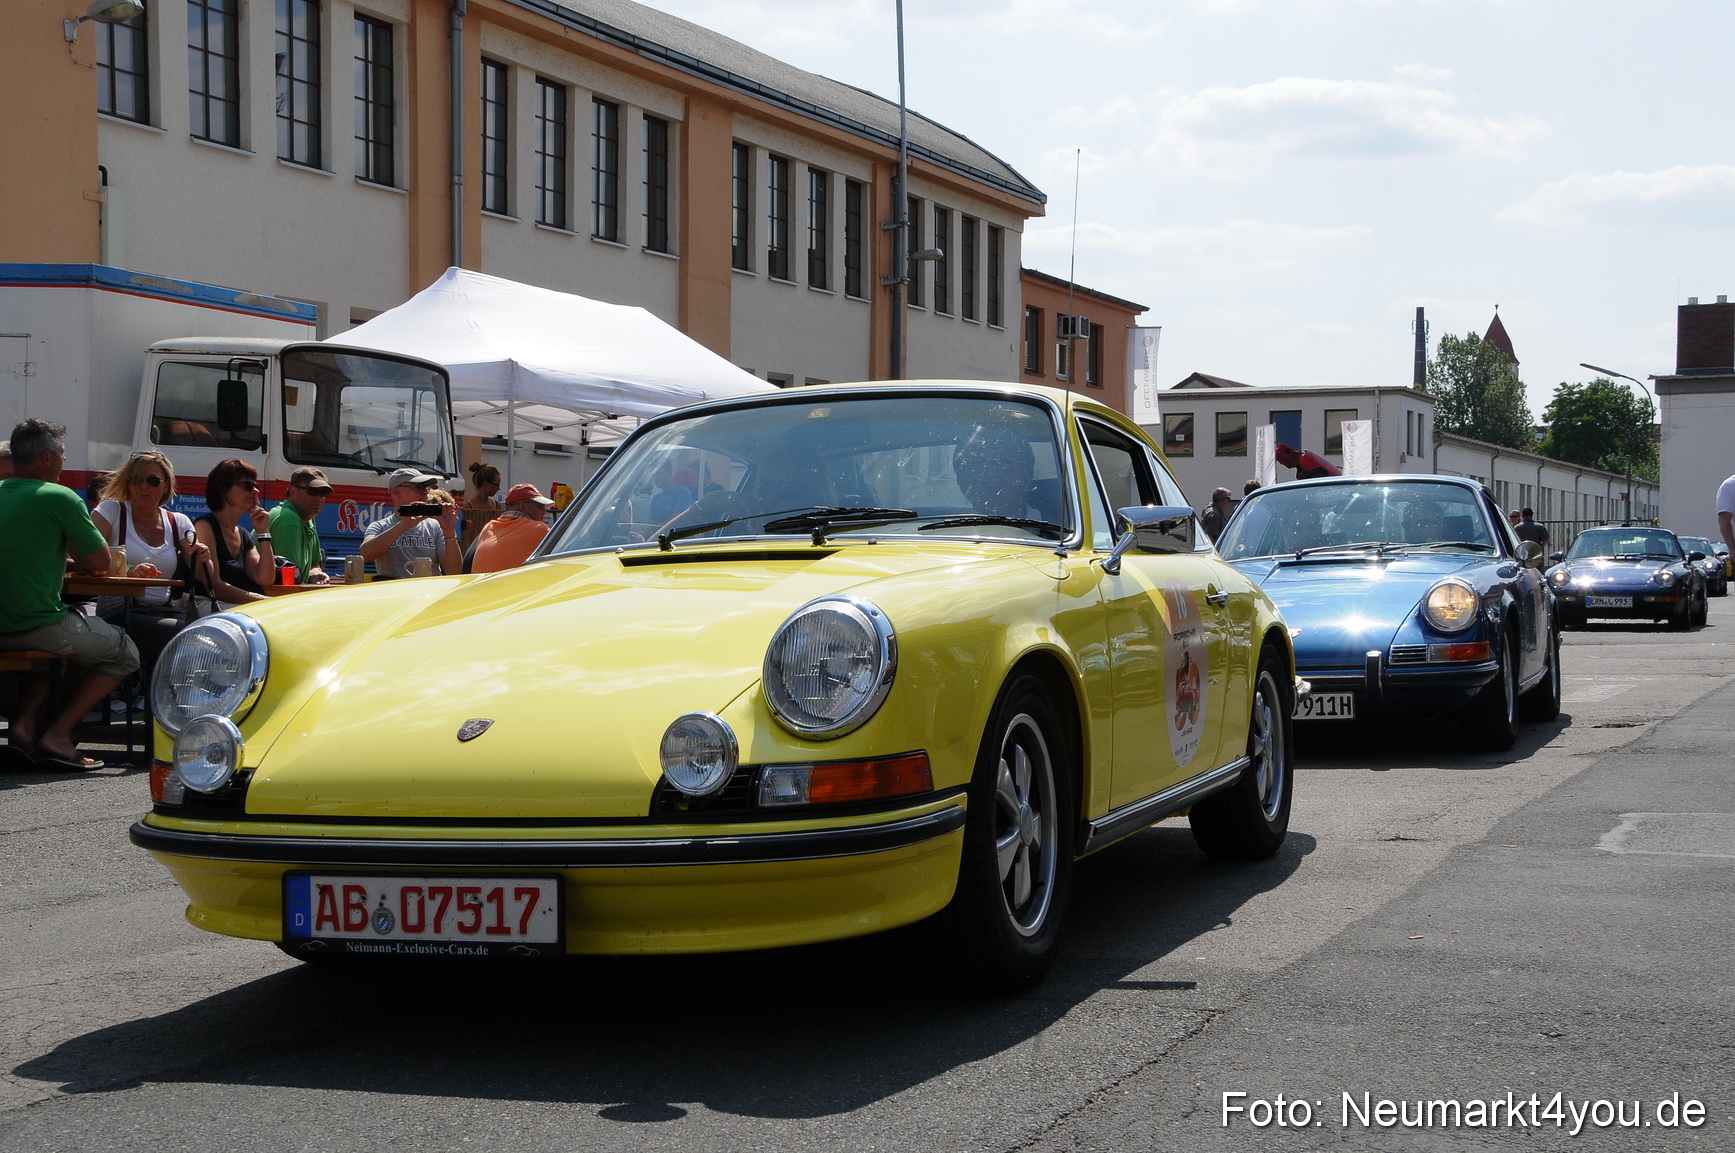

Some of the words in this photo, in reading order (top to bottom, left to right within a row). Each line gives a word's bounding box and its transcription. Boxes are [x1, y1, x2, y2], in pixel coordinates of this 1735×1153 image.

[390, 535, 435, 549] ATTLE
[1174, 628, 1196, 641] PORSCHE
[296, 913, 304, 926] D
[315, 884, 369, 932] AB
[400, 886, 540, 935] 07517
[346, 942, 488, 956] Neimann-Exclusive-Cars.de
